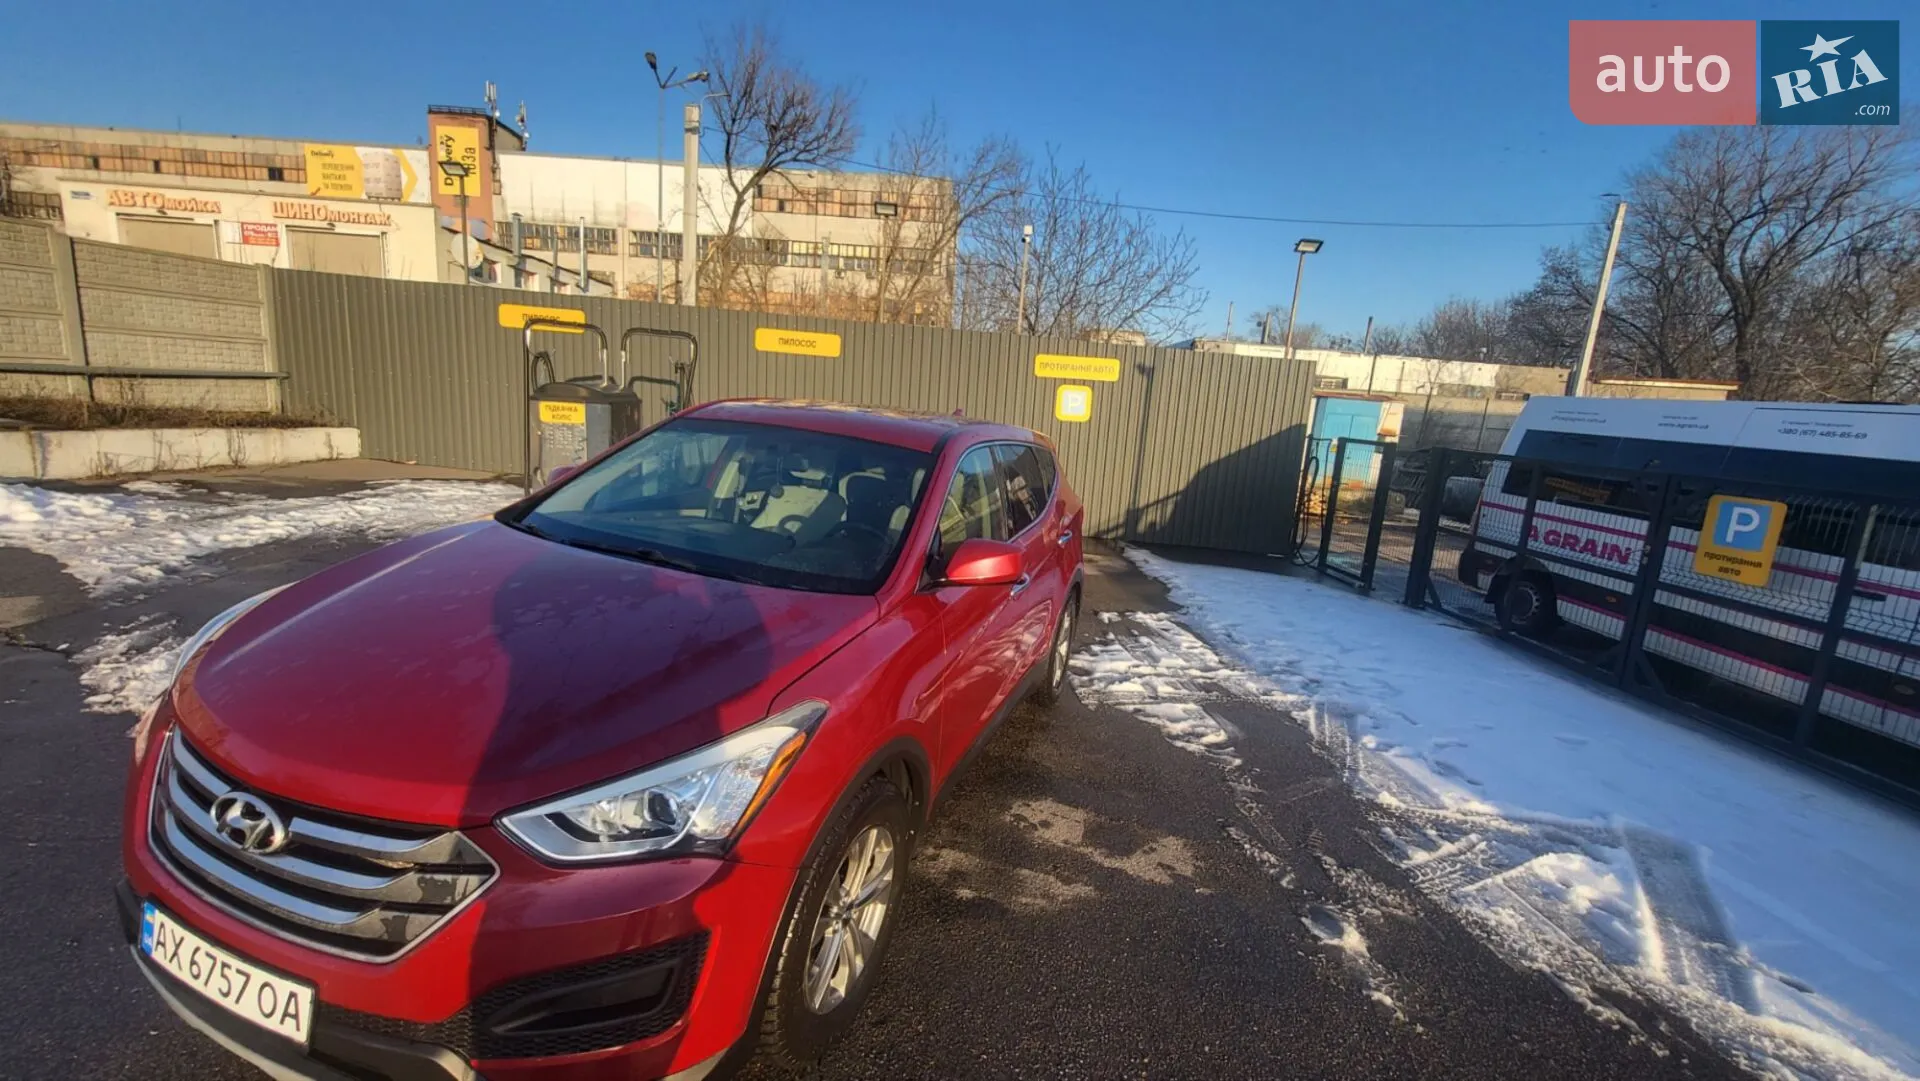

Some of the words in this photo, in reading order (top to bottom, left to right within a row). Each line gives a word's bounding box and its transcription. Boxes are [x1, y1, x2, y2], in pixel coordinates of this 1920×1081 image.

[778, 337, 817, 348] ПИЛОСОС
[1725, 506, 1760, 543] P
[1703, 551, 1764, 569] протирання
[1718, 566, 1742, 577] авто
[154, 920, 185, 972] AX
[189, 945, 252, 1006] 6757
[257, 981, 301, 1032] OA
